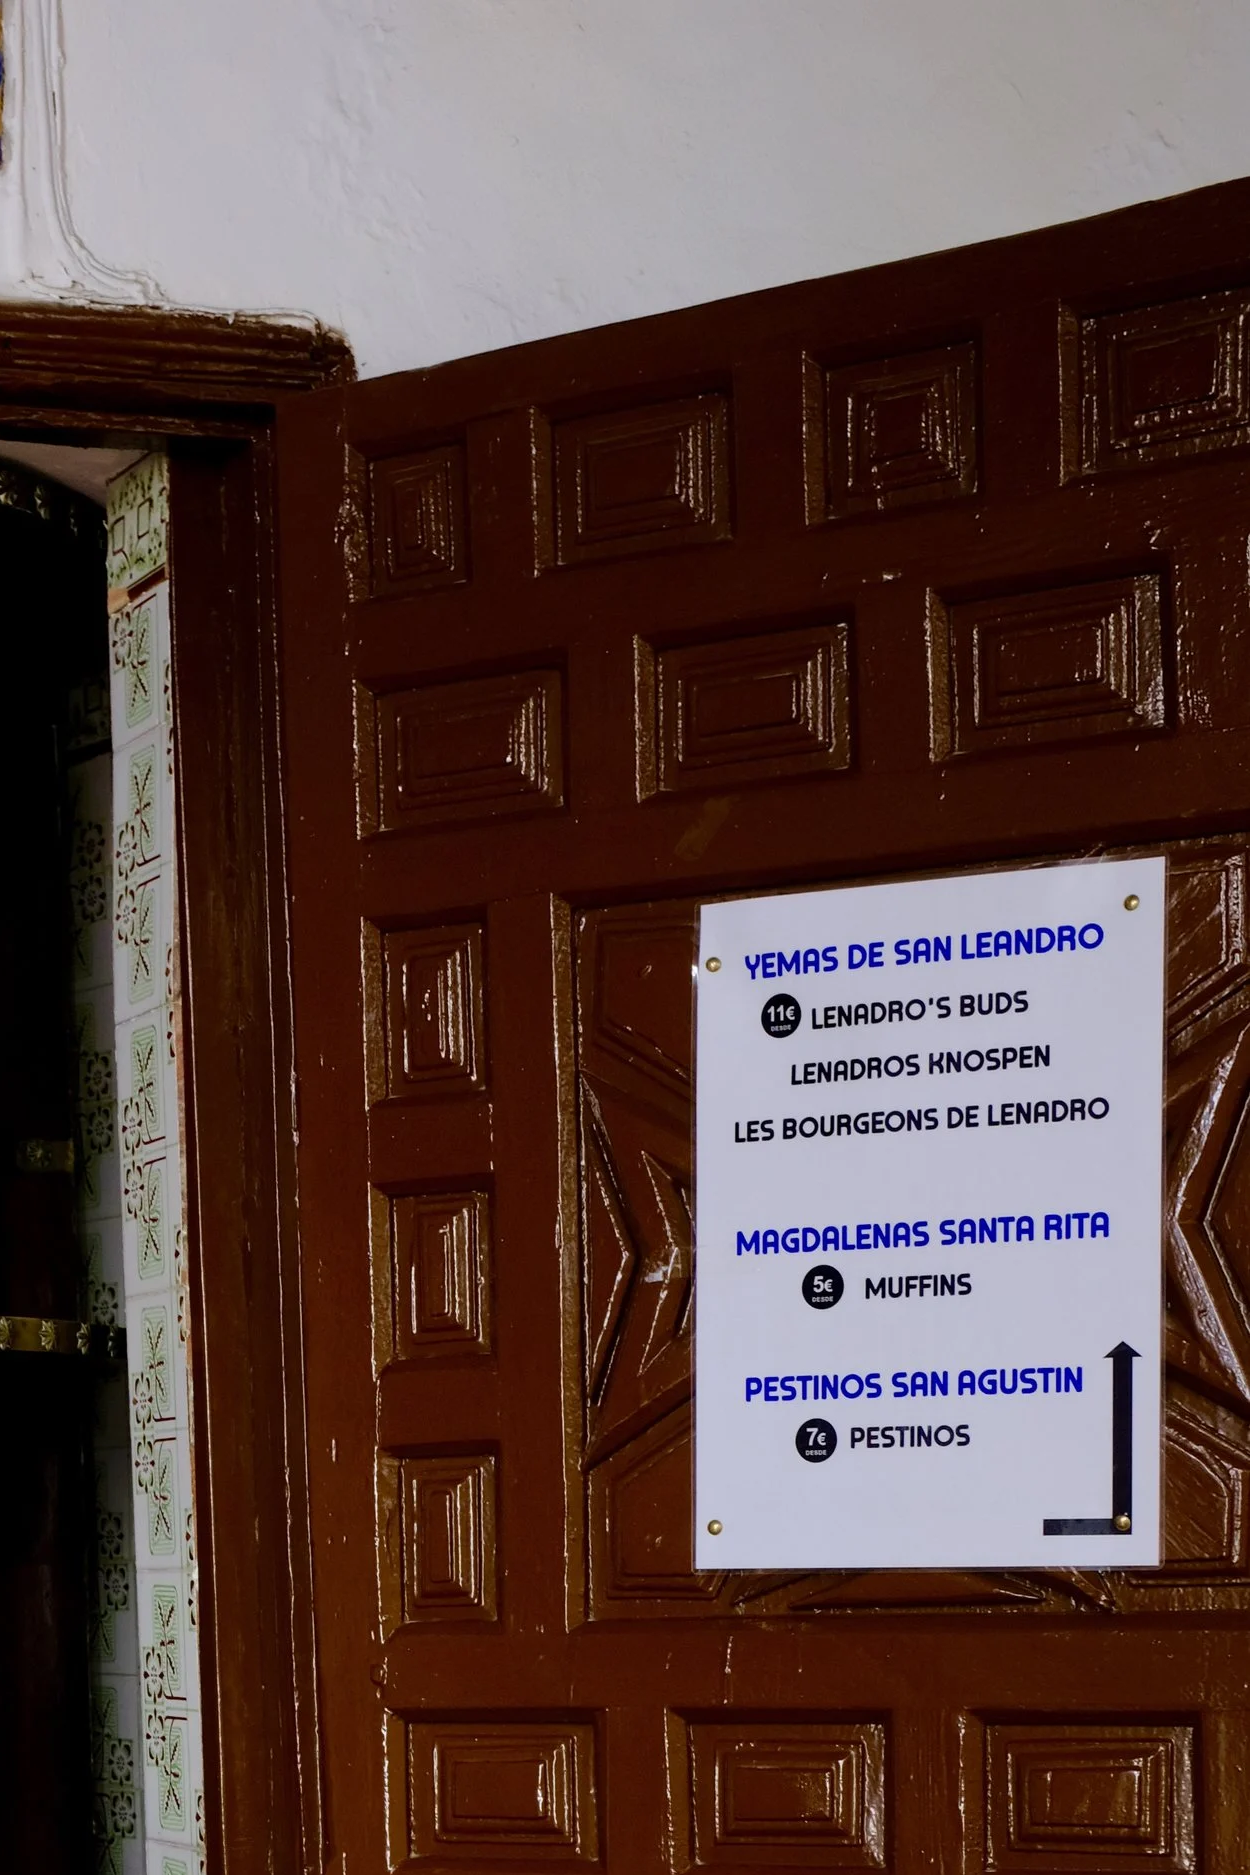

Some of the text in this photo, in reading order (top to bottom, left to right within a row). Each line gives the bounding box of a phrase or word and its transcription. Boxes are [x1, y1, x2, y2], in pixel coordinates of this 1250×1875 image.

[744, 923, 1104, 980] YEMAS DE SAN LEANDRO
[767, 1004, 796, 1022] 11€
[811, 990, 1029, 1030] LENADRO'S BUDS
[790, 1044, 1051, 1086] LENADROS KNOSPEN
[734, 1096, 1110, 1144] LES BOURGEONS DE LENADRO
[736, 1211, 1110, 1256] MAGDALENAS SANTA RITA
[813, 1275, 833, 1293] 5€
[865, 1272, 972, 1300] MUFFINS
[745, 1366, 1083, 1403] PESTINOS SAN AGUSTIN
[806, 1427, 827, 1446] 7€
[850, 1424, 971, 1449] PESTINOS
